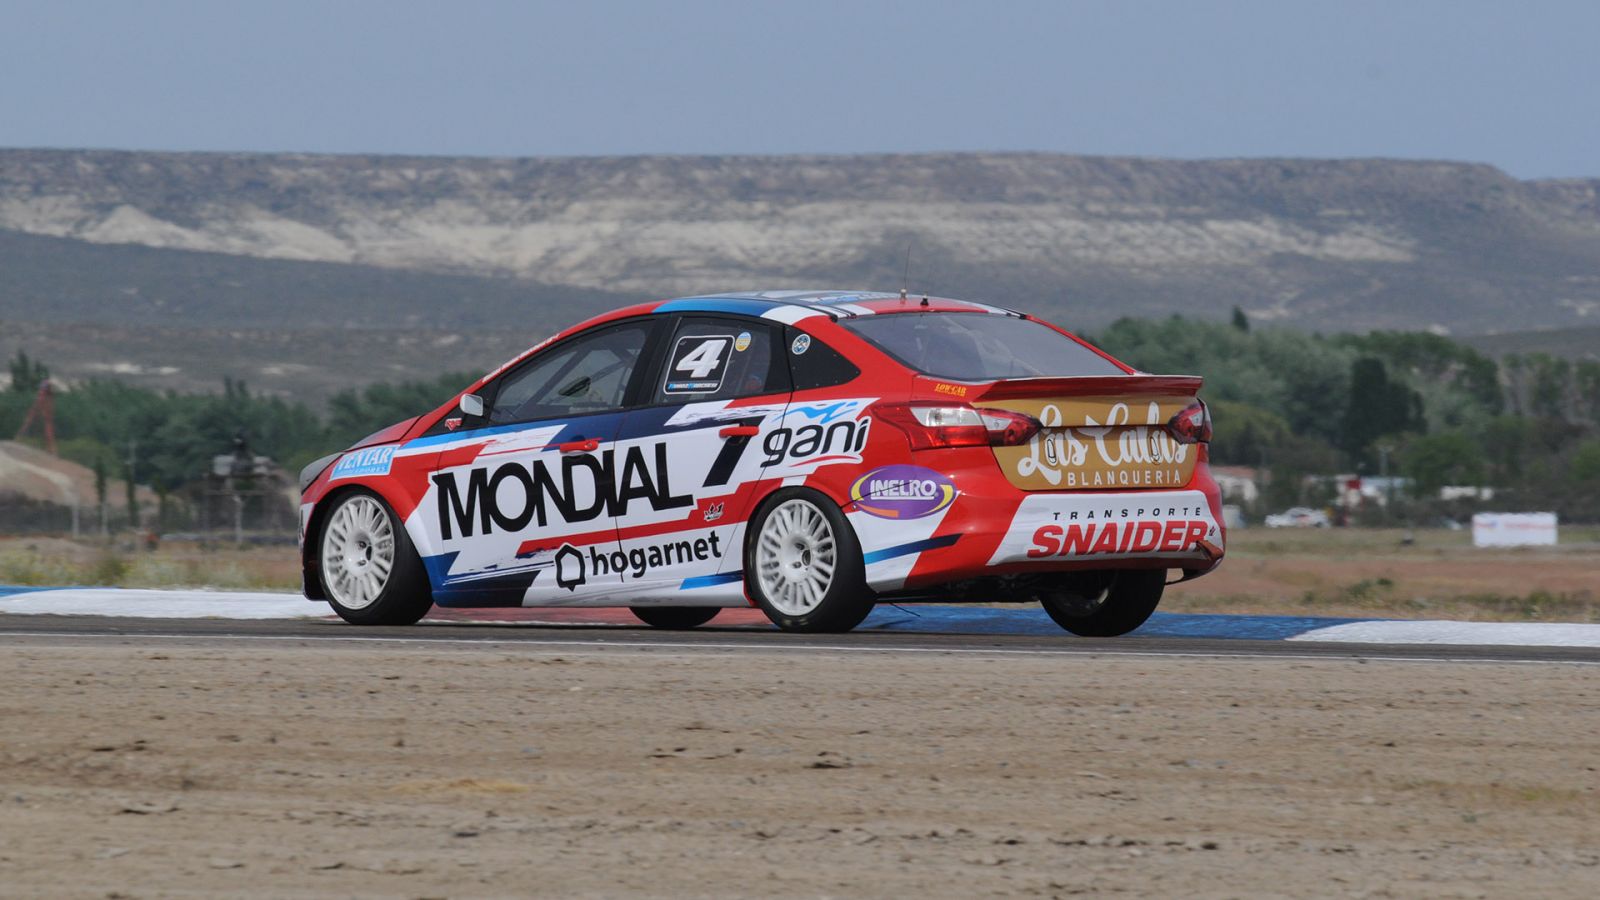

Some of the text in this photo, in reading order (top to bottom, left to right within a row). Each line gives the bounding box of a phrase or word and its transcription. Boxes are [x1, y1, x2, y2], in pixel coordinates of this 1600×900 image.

[675, 339, 727, 379] 4
[759, 419, 869, 468] gani
[1017, 404, 1088, 485] Las
[432, 442, 694, 540] MONDIAL
[869, 479, 937, 498] INELRO
[1067, 469, 1182, 487] BLANQUERIA
[1052, 507, 1202, 521] TRANSPORTE
[590, 530, 722, 578] hogarnet
[1026, 520, 1209, 558] SNAIDER
